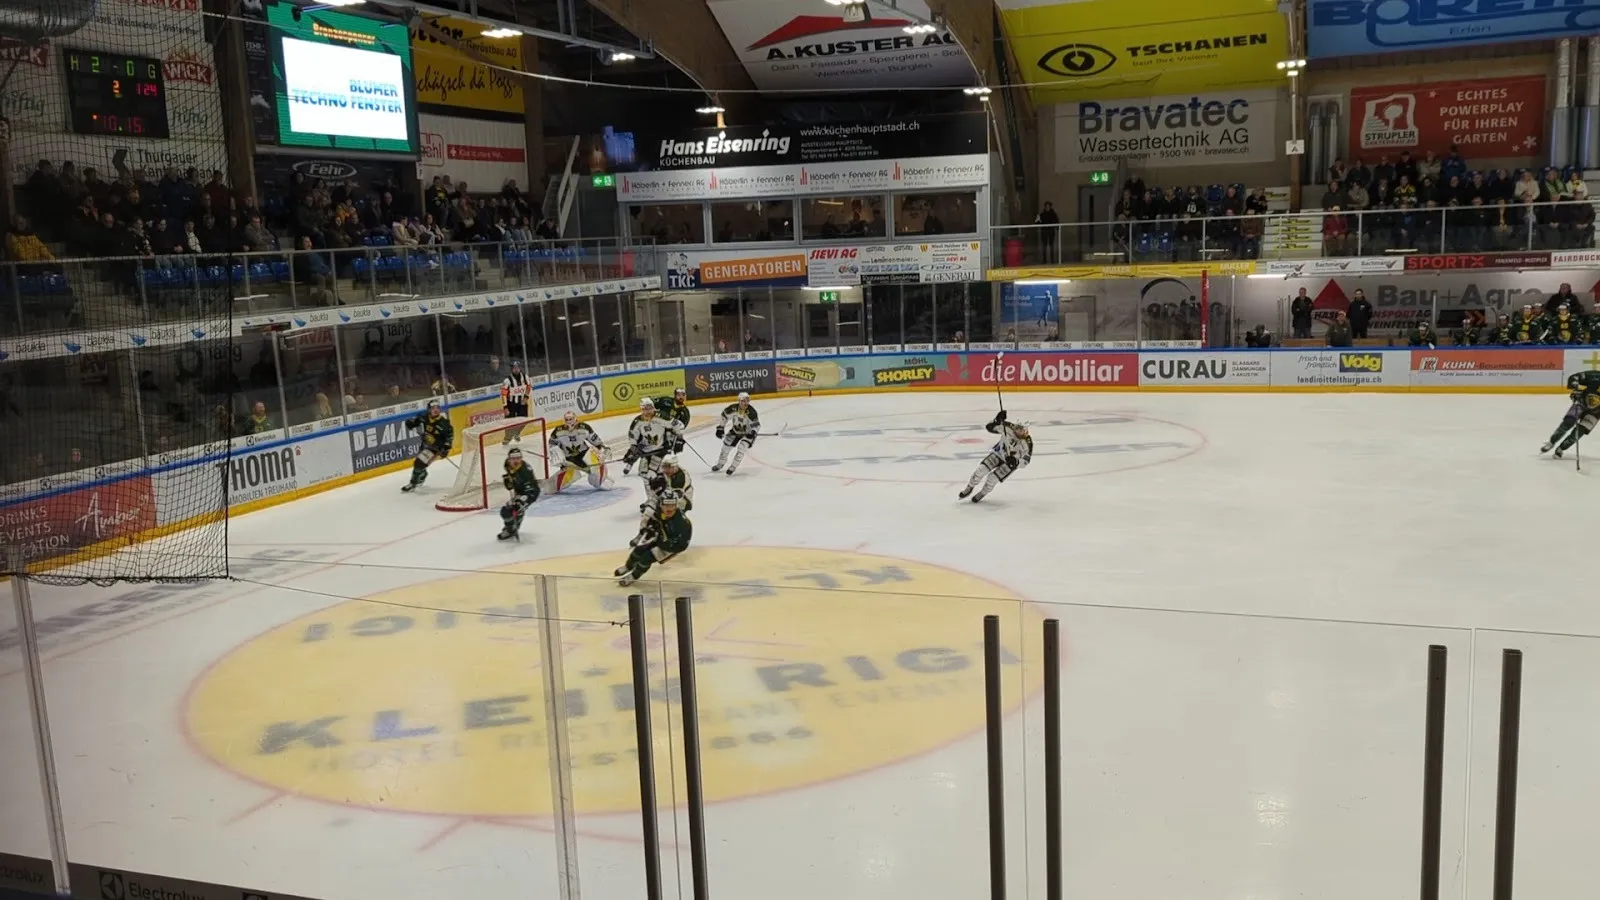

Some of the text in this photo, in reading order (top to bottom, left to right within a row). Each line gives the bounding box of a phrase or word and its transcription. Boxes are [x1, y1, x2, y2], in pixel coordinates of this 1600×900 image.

[766, 36, 914, 60] A.KUSTER
[1126, 33, 1267, 57] TSCHANEN
[71, 56, 80, 70] H
[91, 56, 100, 73] 2
[127, 60, 134, 76] 0
[148, 64, 156, 79] G
[165, 62, 209, 83] WICK
[136, 82, 157, 96] 124
[1456, 88, 1508, 101] ECHTES
[1078, 97, 1250, 135] Bravatec
[1439, 101, 1525, 117] POWERPLAY
[800, 120, 921, 136] www.küchenhauptstadt.ch
[1444, 116, 1519, 131] FÜR IHREN
[1079, 127, 1250, 154] Wassertechnik AG
[1365, 130, 1416, 141] STRUPLER
[1453, 132, 1508, 145] GARTEN
[660, 140, 704, 158] Hans
[705, 129, 791, 155] Eisenring
[136, 149, 198, 166] Thurgauer
[660, 156, 716, 167] KÜCHENBAU
[309, 162, 344, 176] Fehr
[810, 249, 840, 260] SIEVI
[841, 248, 858, 259] AG
[704, 259, 802, 280] GENERATOREN
[1407, 255, 1485, 269] SPORTX
[669, 274, 696, 288] TKC
[931, 272, 976, 281] GENERALI
[904, 357, 928, 366] MÖHL
[1298, 355, 1320, 363] frisch
[1341, 353, 1382, 371] Volg
[709, 368, 769, 383] SWISS CASINO
[780, 367, 816, 381] SHORLEY
[876, 367, 933, 383] SHORLEY
[981, 359, 1124, 382] die Mobiliar
[636, 380, 674, 391] TSCHANEN
[710, 380, 754, 393] ST.GALLEN
[533, 395, 549, 407] von
[550, 388, 576, 402] Büren
[353, 427, 378, 452] DE
[215, 447, 297, 492] THOMA
[264, 481, 298, 496] TREUHAND
